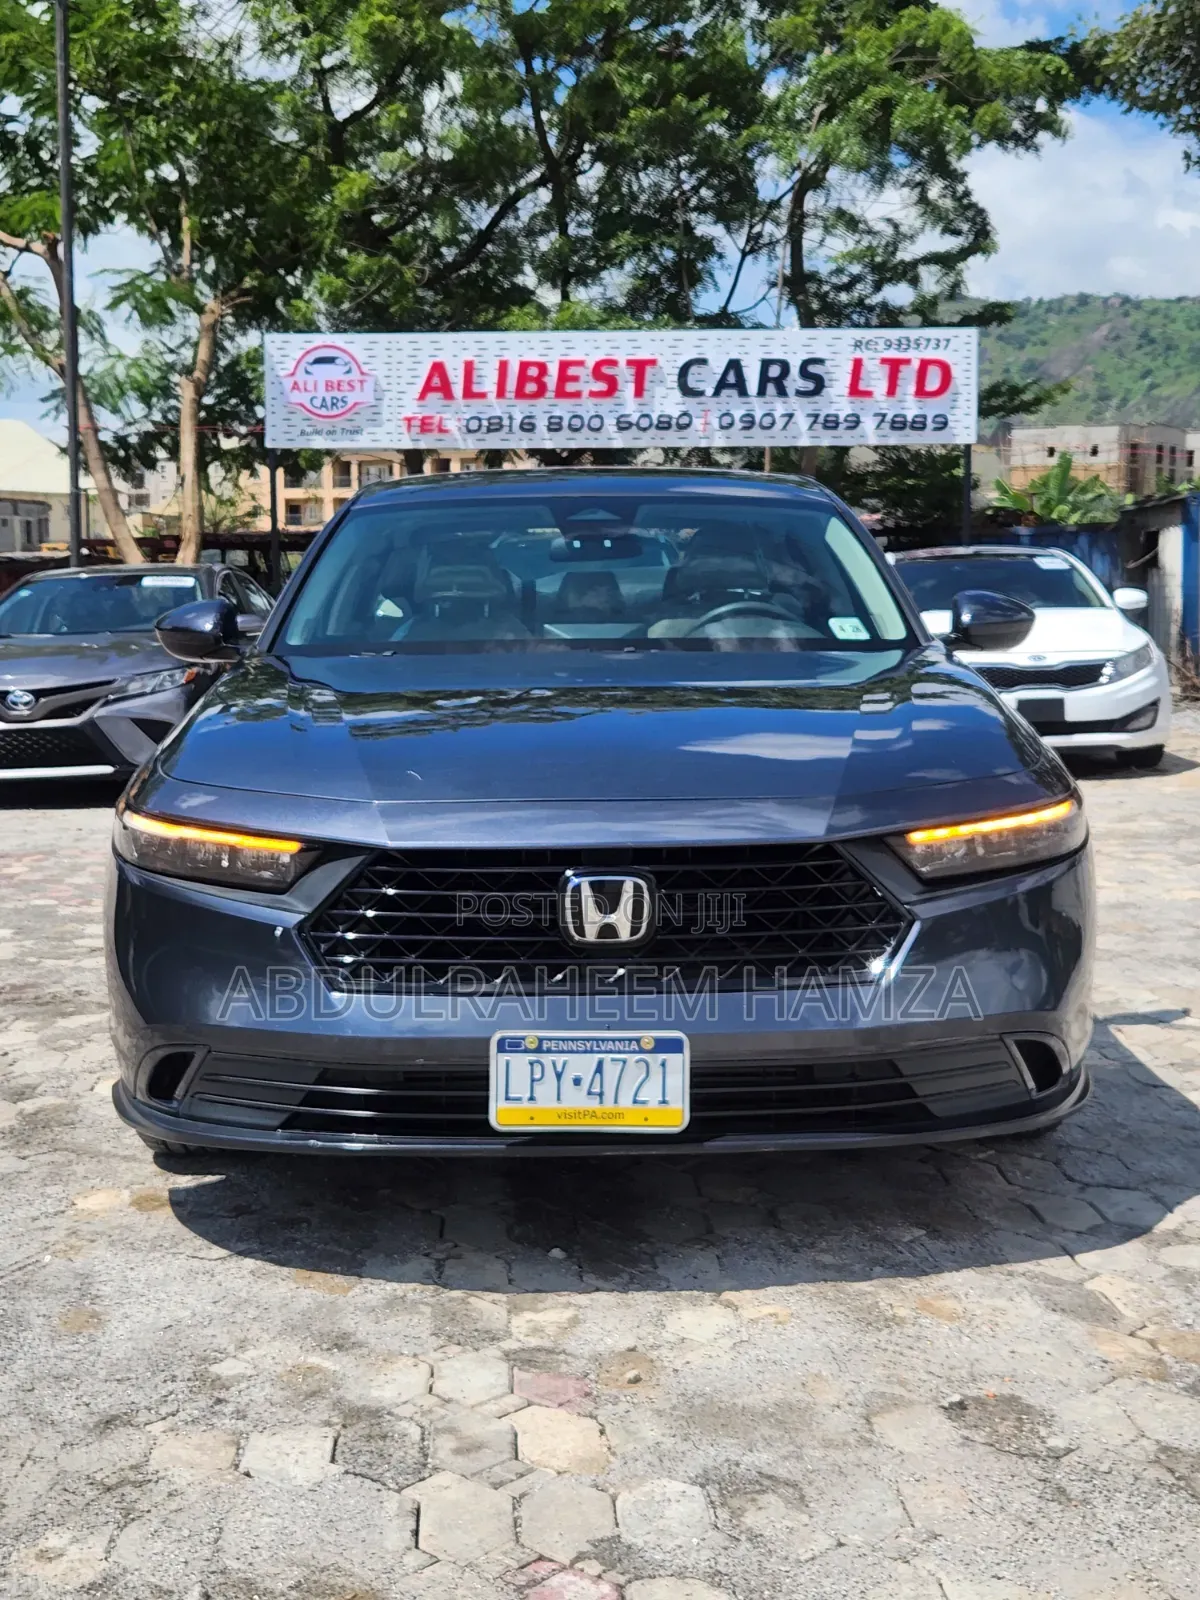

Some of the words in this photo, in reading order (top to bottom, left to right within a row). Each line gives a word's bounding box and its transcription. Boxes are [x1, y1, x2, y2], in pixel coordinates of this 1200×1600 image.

[883, 337, 952, 351] 9335737
[417, 357, 659, 401] ALIBEST
[677, 357, 826, 400] CARS
[847, 356, 953, 400] LTD
[290, 379, 319, 393] ALI
[325, 379, 369, 393] BEST
[309, 395, 349, 412] CARS
[465, 415, 537, 434] 0816
[546, 414, 605, 433] 800
[614, 413, 693, 432] 6080
[718, 412, 796, 432] 0907
[806, 412, 862, 431] 789
[872, 412, 950, 432] 7889
[340, 427, 364, 436] Trust
[542, 1039, 640, 1053] PENNSYLVANIA
[556, 1109, 625, 1121] visitPA.com
